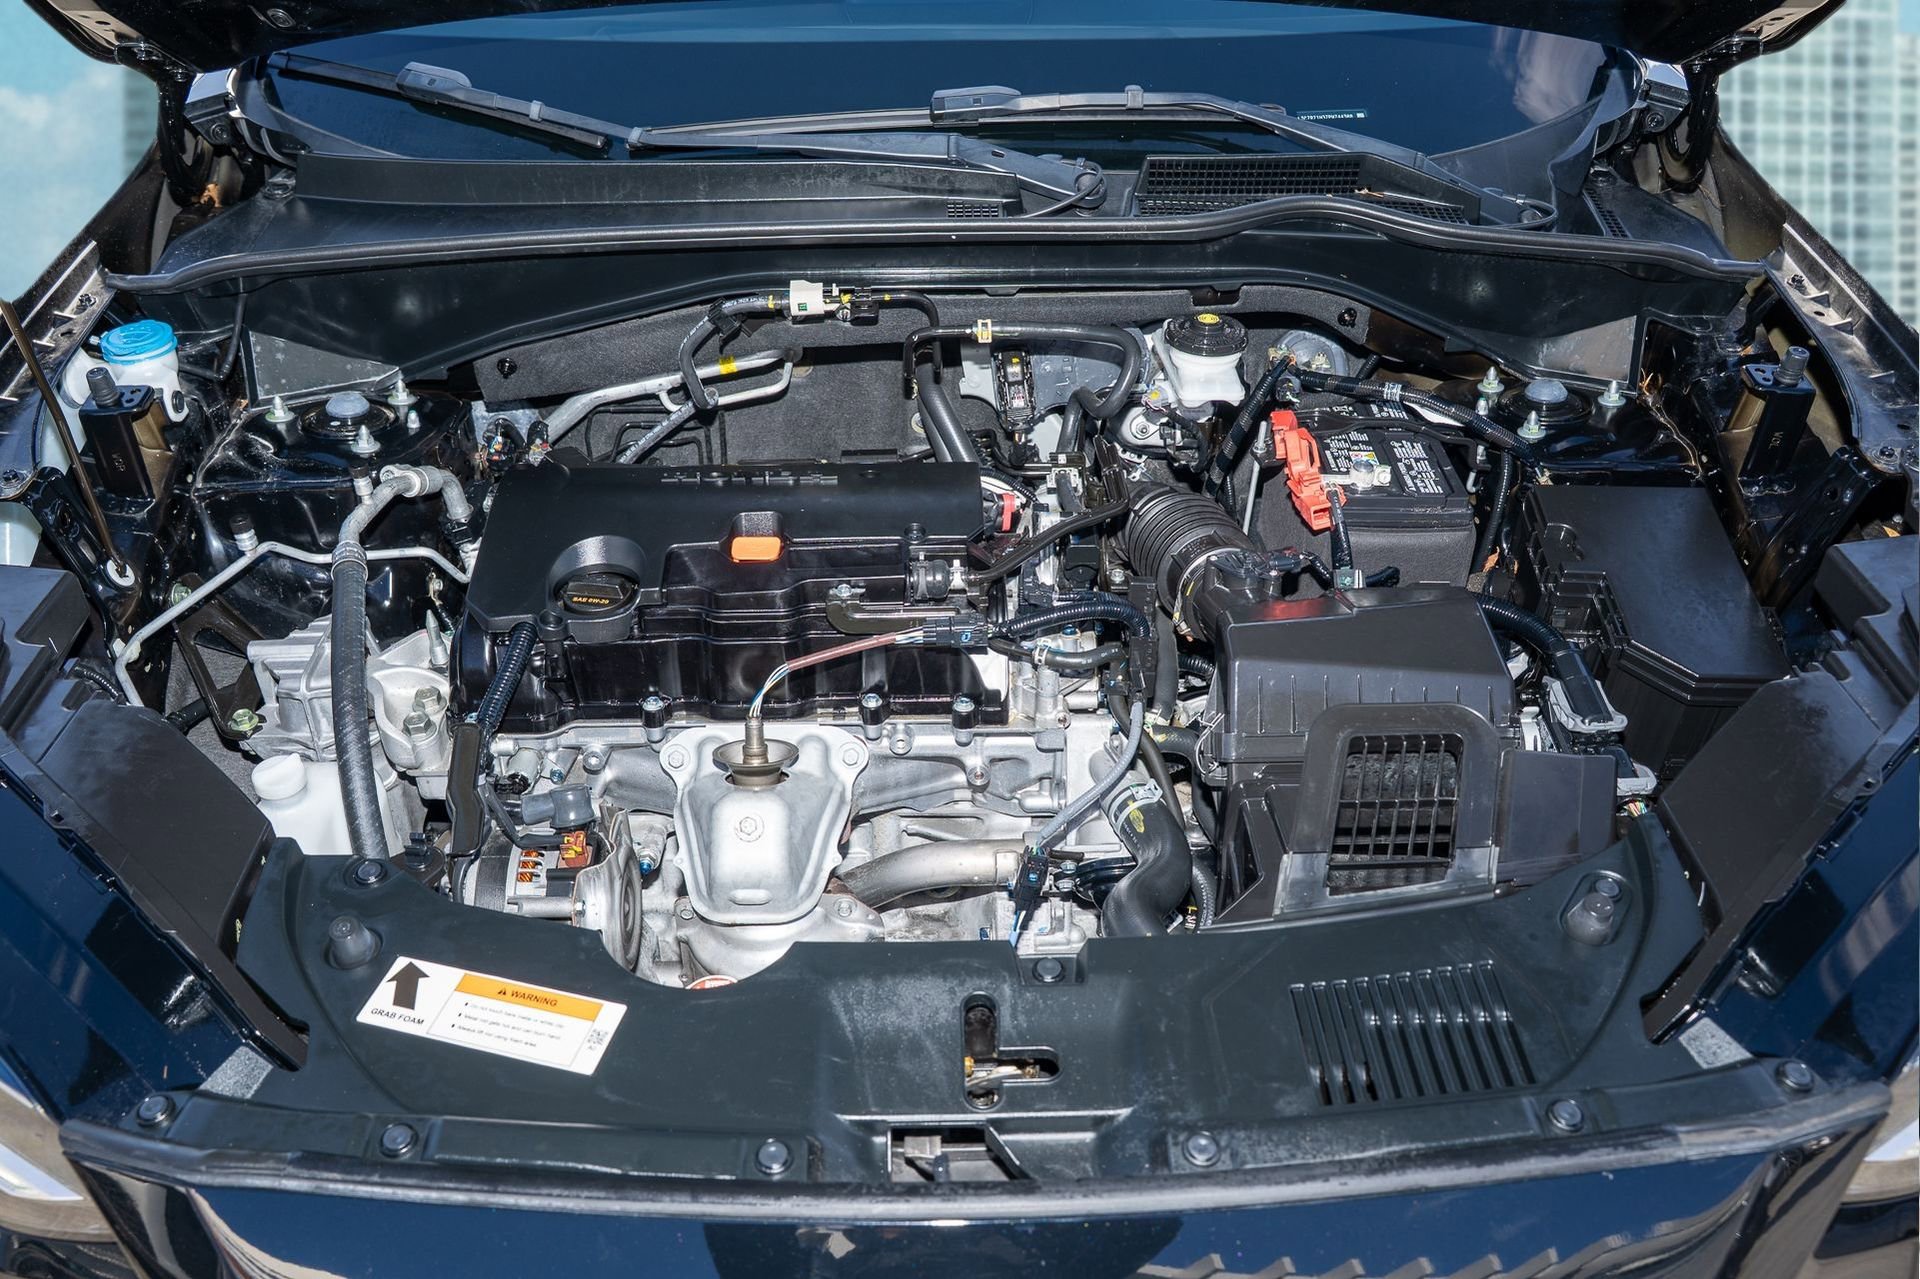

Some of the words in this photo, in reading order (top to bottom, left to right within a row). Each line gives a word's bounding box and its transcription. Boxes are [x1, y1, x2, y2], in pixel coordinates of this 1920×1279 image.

[511, 990, 558, 1007] WARNING
[370, 1008, 397, 1019] GRAB
[398, 1014, 425, 1026] FOAM
